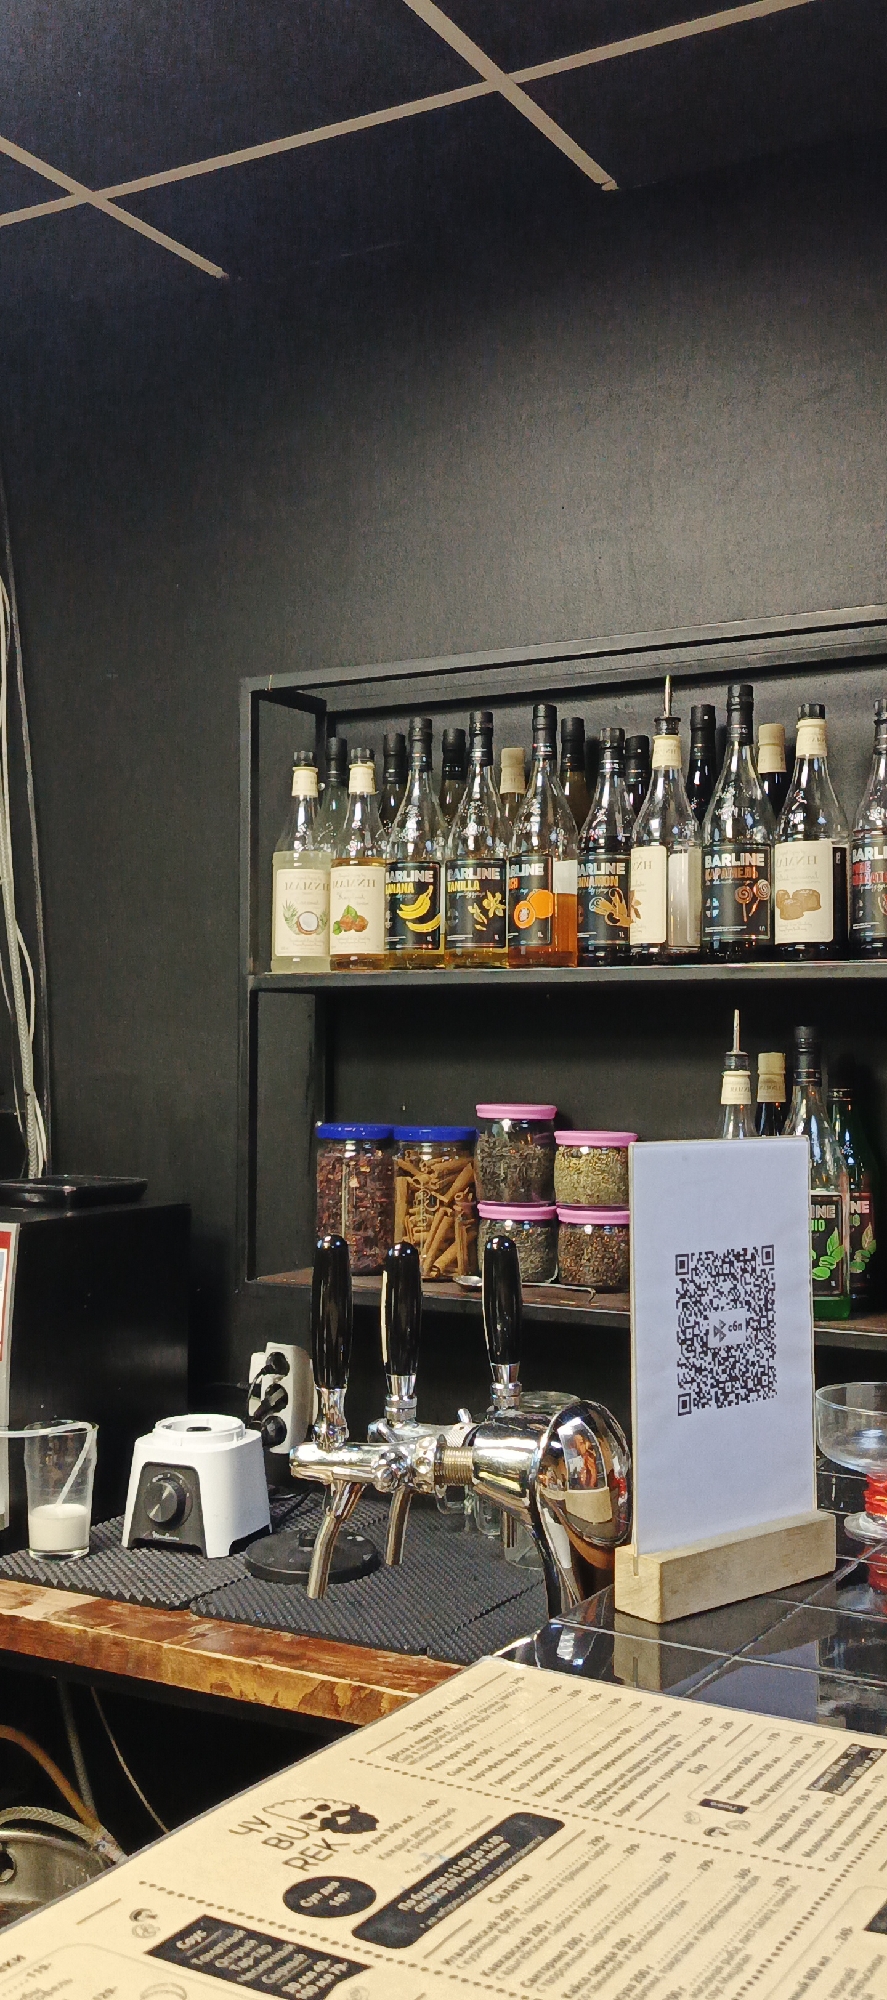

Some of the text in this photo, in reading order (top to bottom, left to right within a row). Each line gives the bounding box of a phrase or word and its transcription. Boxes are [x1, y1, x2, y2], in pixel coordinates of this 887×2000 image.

[705, 853, 765, 868] BARLINE
[447, 867, 500, 881] BARLINE
[509, 863, 544, 877] RLINE
[448, 880, 480, 892] VANILLA
[728, 1321, 743, 1333] сбп
[405, 1710, 446, 1732] Закуски
[446, 1766, 466, 1776] Сыр
[687, 1763, 709, 1775] Бар
[703, 1783, 724, 1796] Пиво
[726, 1788, 747, 1801] Пиво
[750, 1793, 771, 1806] Пиво
[228, 1815, 272, 1835] ЧУ
[261, 1825, 310, 1850] BU
[752, 1822, 785, 1847] Лимонад
[776, 1828, 809, 1853] Лимонад
[282, 1837, 350, 1872] REK
[352, 1844, 372, 1855] Суп
[487, 1874, 532, 1904] Салаты
[494, 1909, 515, 1922] 200
[527, 1924, 548, 1937] 200
[176, 1930, 207, 1949] Соус
[562, 1937, 583, 1951] 200
[611, 1938, 632, 1951] 200
